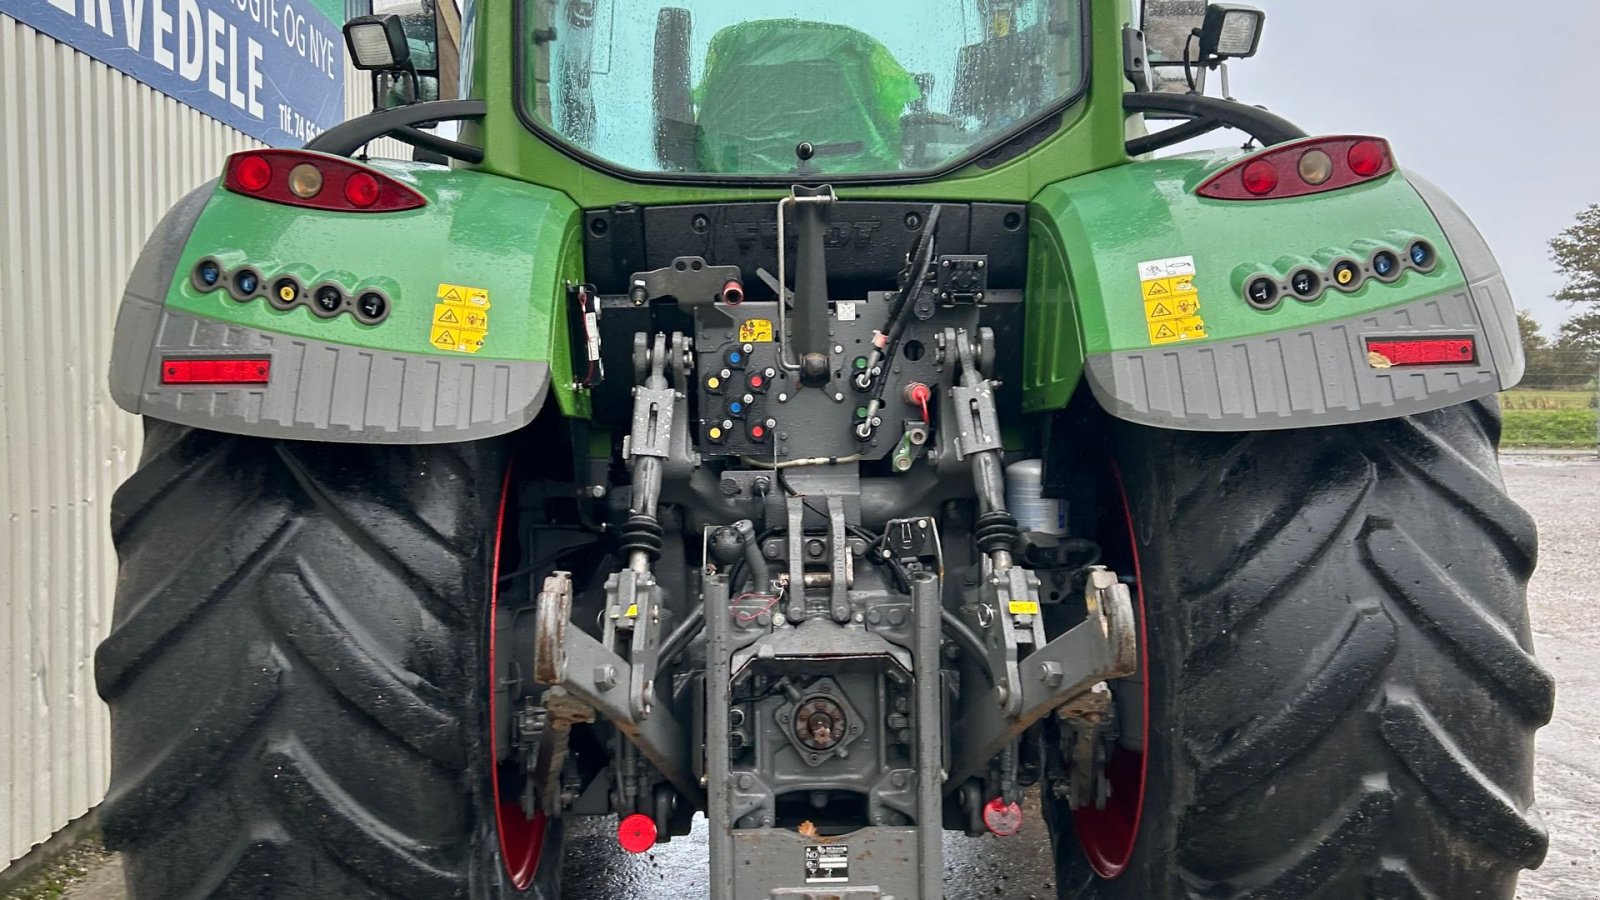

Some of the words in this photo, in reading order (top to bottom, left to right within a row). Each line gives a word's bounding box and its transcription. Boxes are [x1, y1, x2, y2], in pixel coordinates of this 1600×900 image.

[47, 0, 264, 120] VEDELE
[284, 4, 305, 57] OG
[309, 24, 335, 80] NYE
[279, 103, 293, 136] Tlf.
[294, 112, 305, 142] 74
